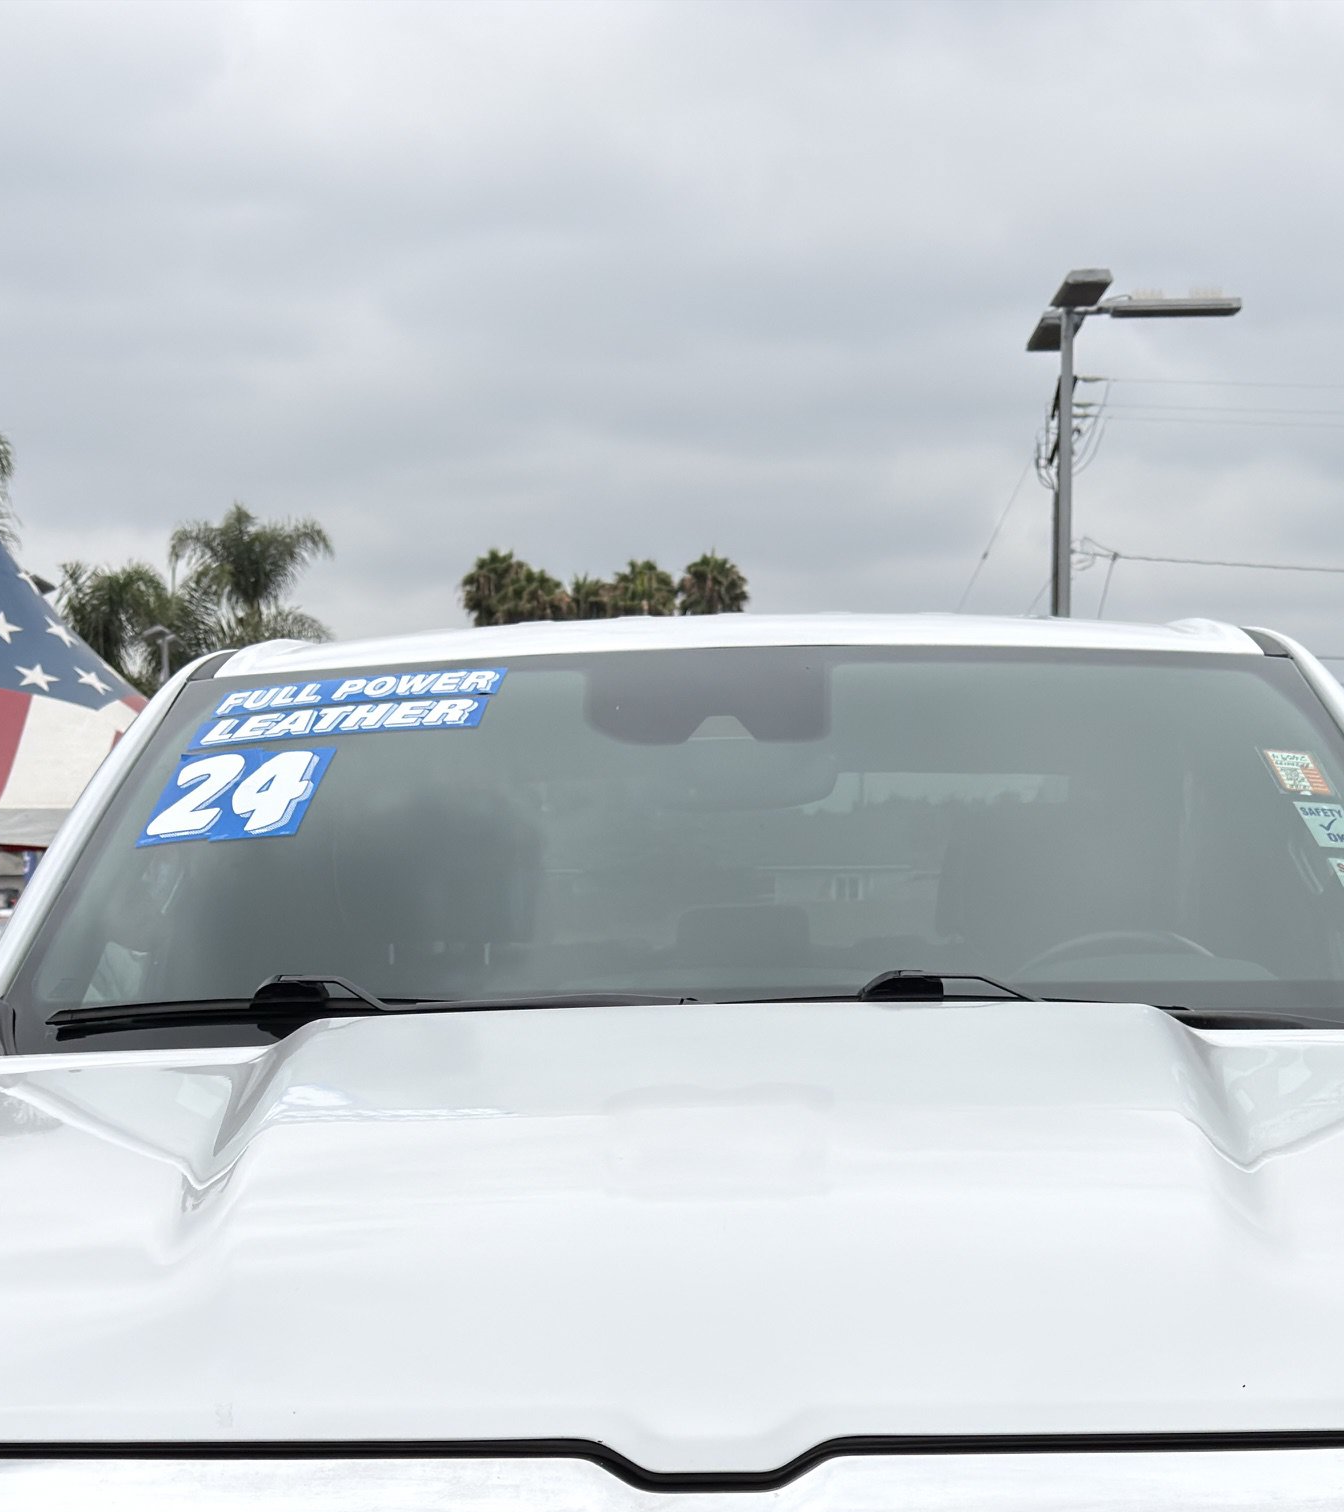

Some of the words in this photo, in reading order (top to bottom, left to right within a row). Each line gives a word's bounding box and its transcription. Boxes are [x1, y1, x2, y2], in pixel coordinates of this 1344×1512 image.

[216, 683, 322, 715] FULL
[331, 670, 499, 701] POWER
[200, 698, 479, 745] LEATHER
[146, 751, 321, 838] 24
[1300, 806, 1343, 818] SAFETY
